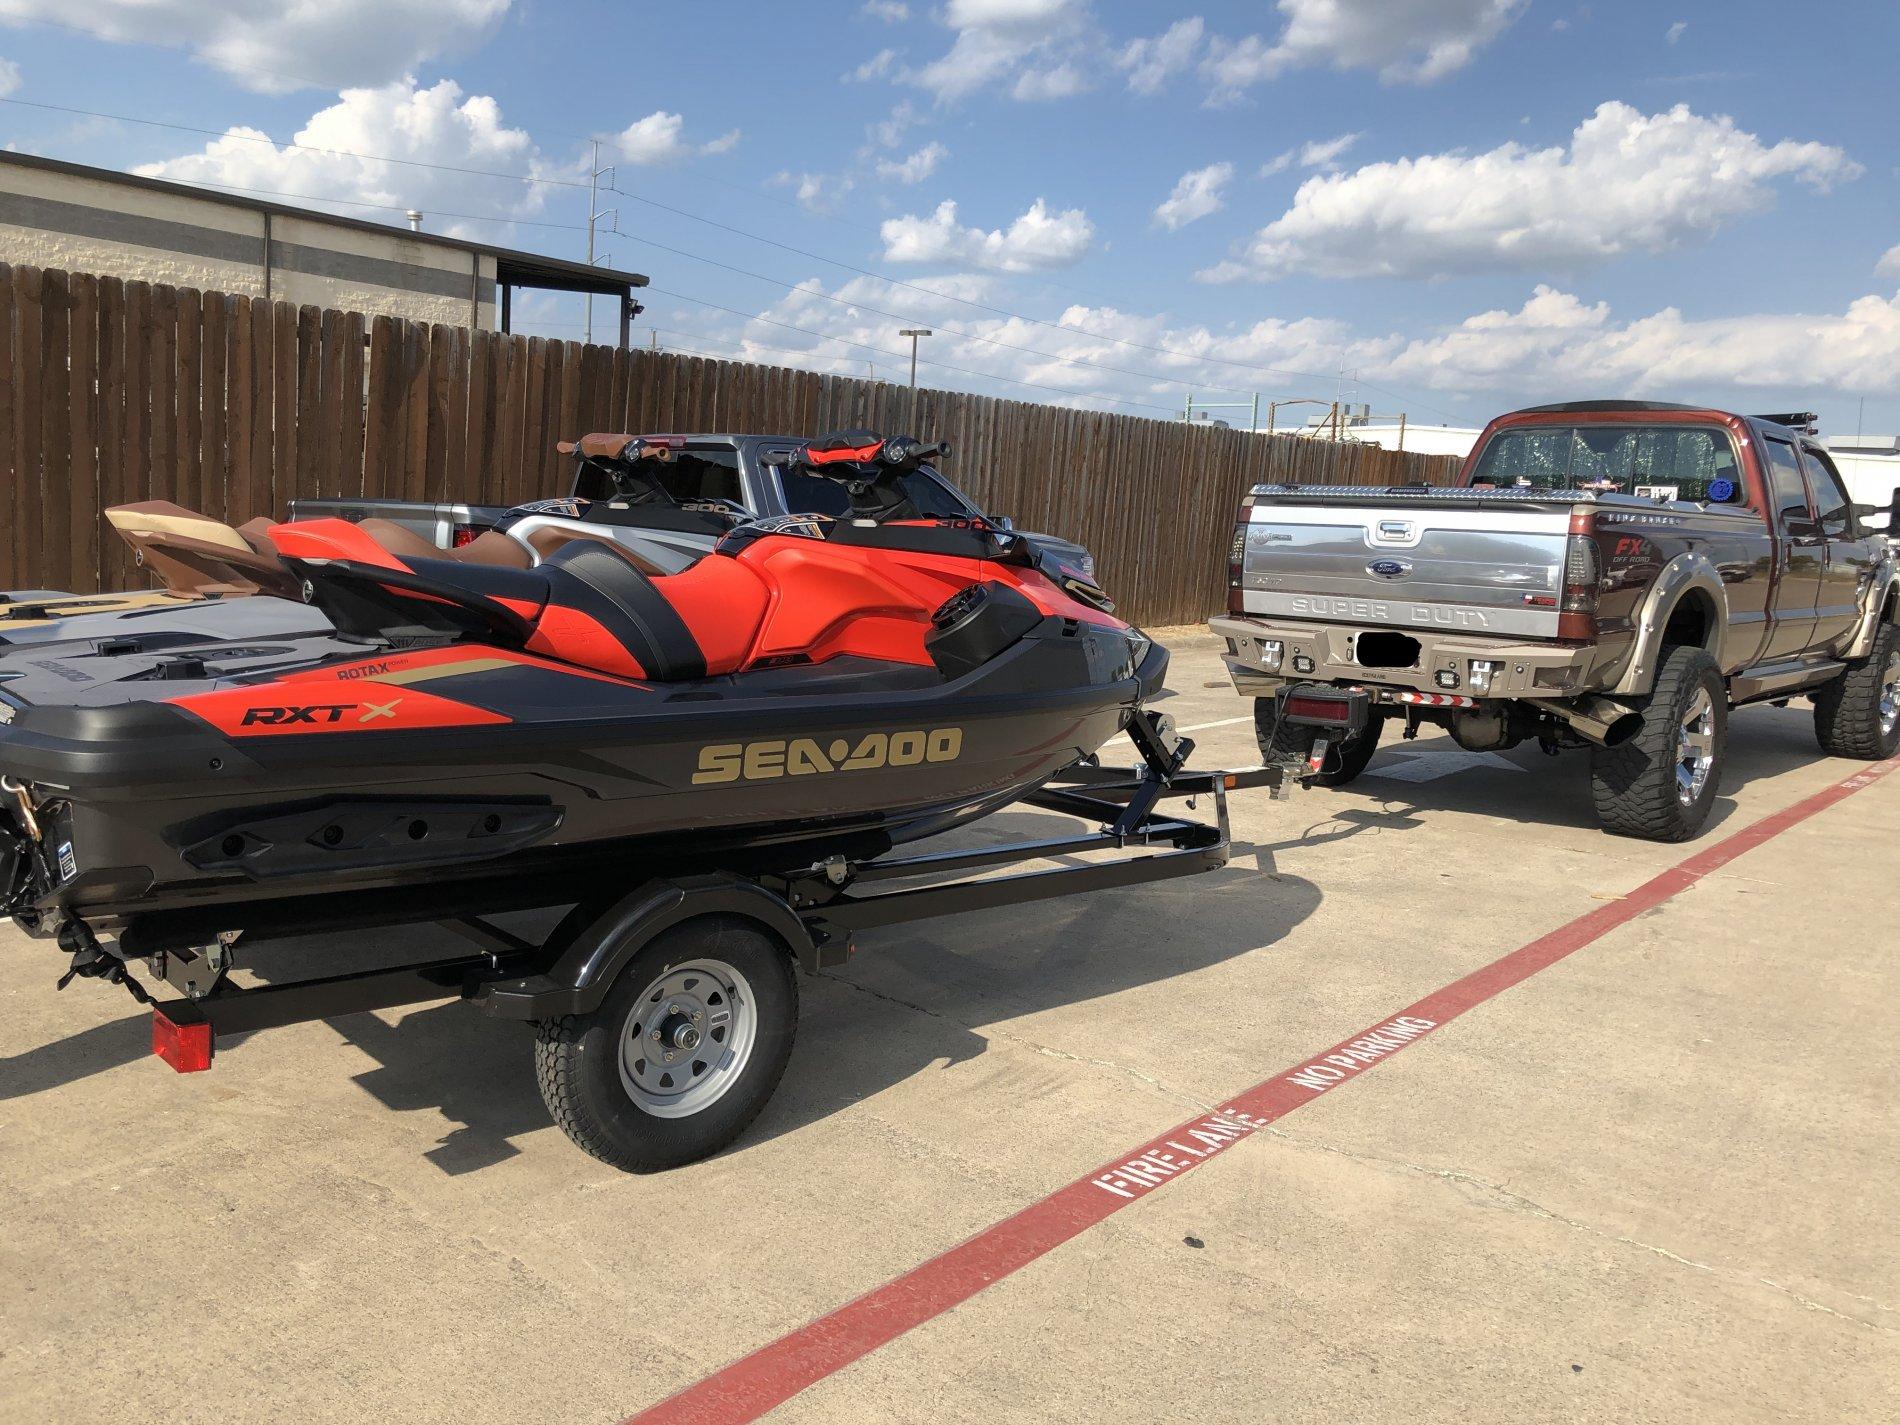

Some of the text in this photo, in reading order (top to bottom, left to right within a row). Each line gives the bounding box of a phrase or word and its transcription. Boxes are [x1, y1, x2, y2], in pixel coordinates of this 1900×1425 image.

[681, 503, 730, 514] 300
[1615, 537, 1652, 556] FX4
[1292, 599, 1496, 627] SUPER DUTY
[337, 662, 390, 681] ROTAX
[240, 698, 404, 726] RXT X
[1091, 1016, 1438, 1198] FIRE LANE NO PARKING
